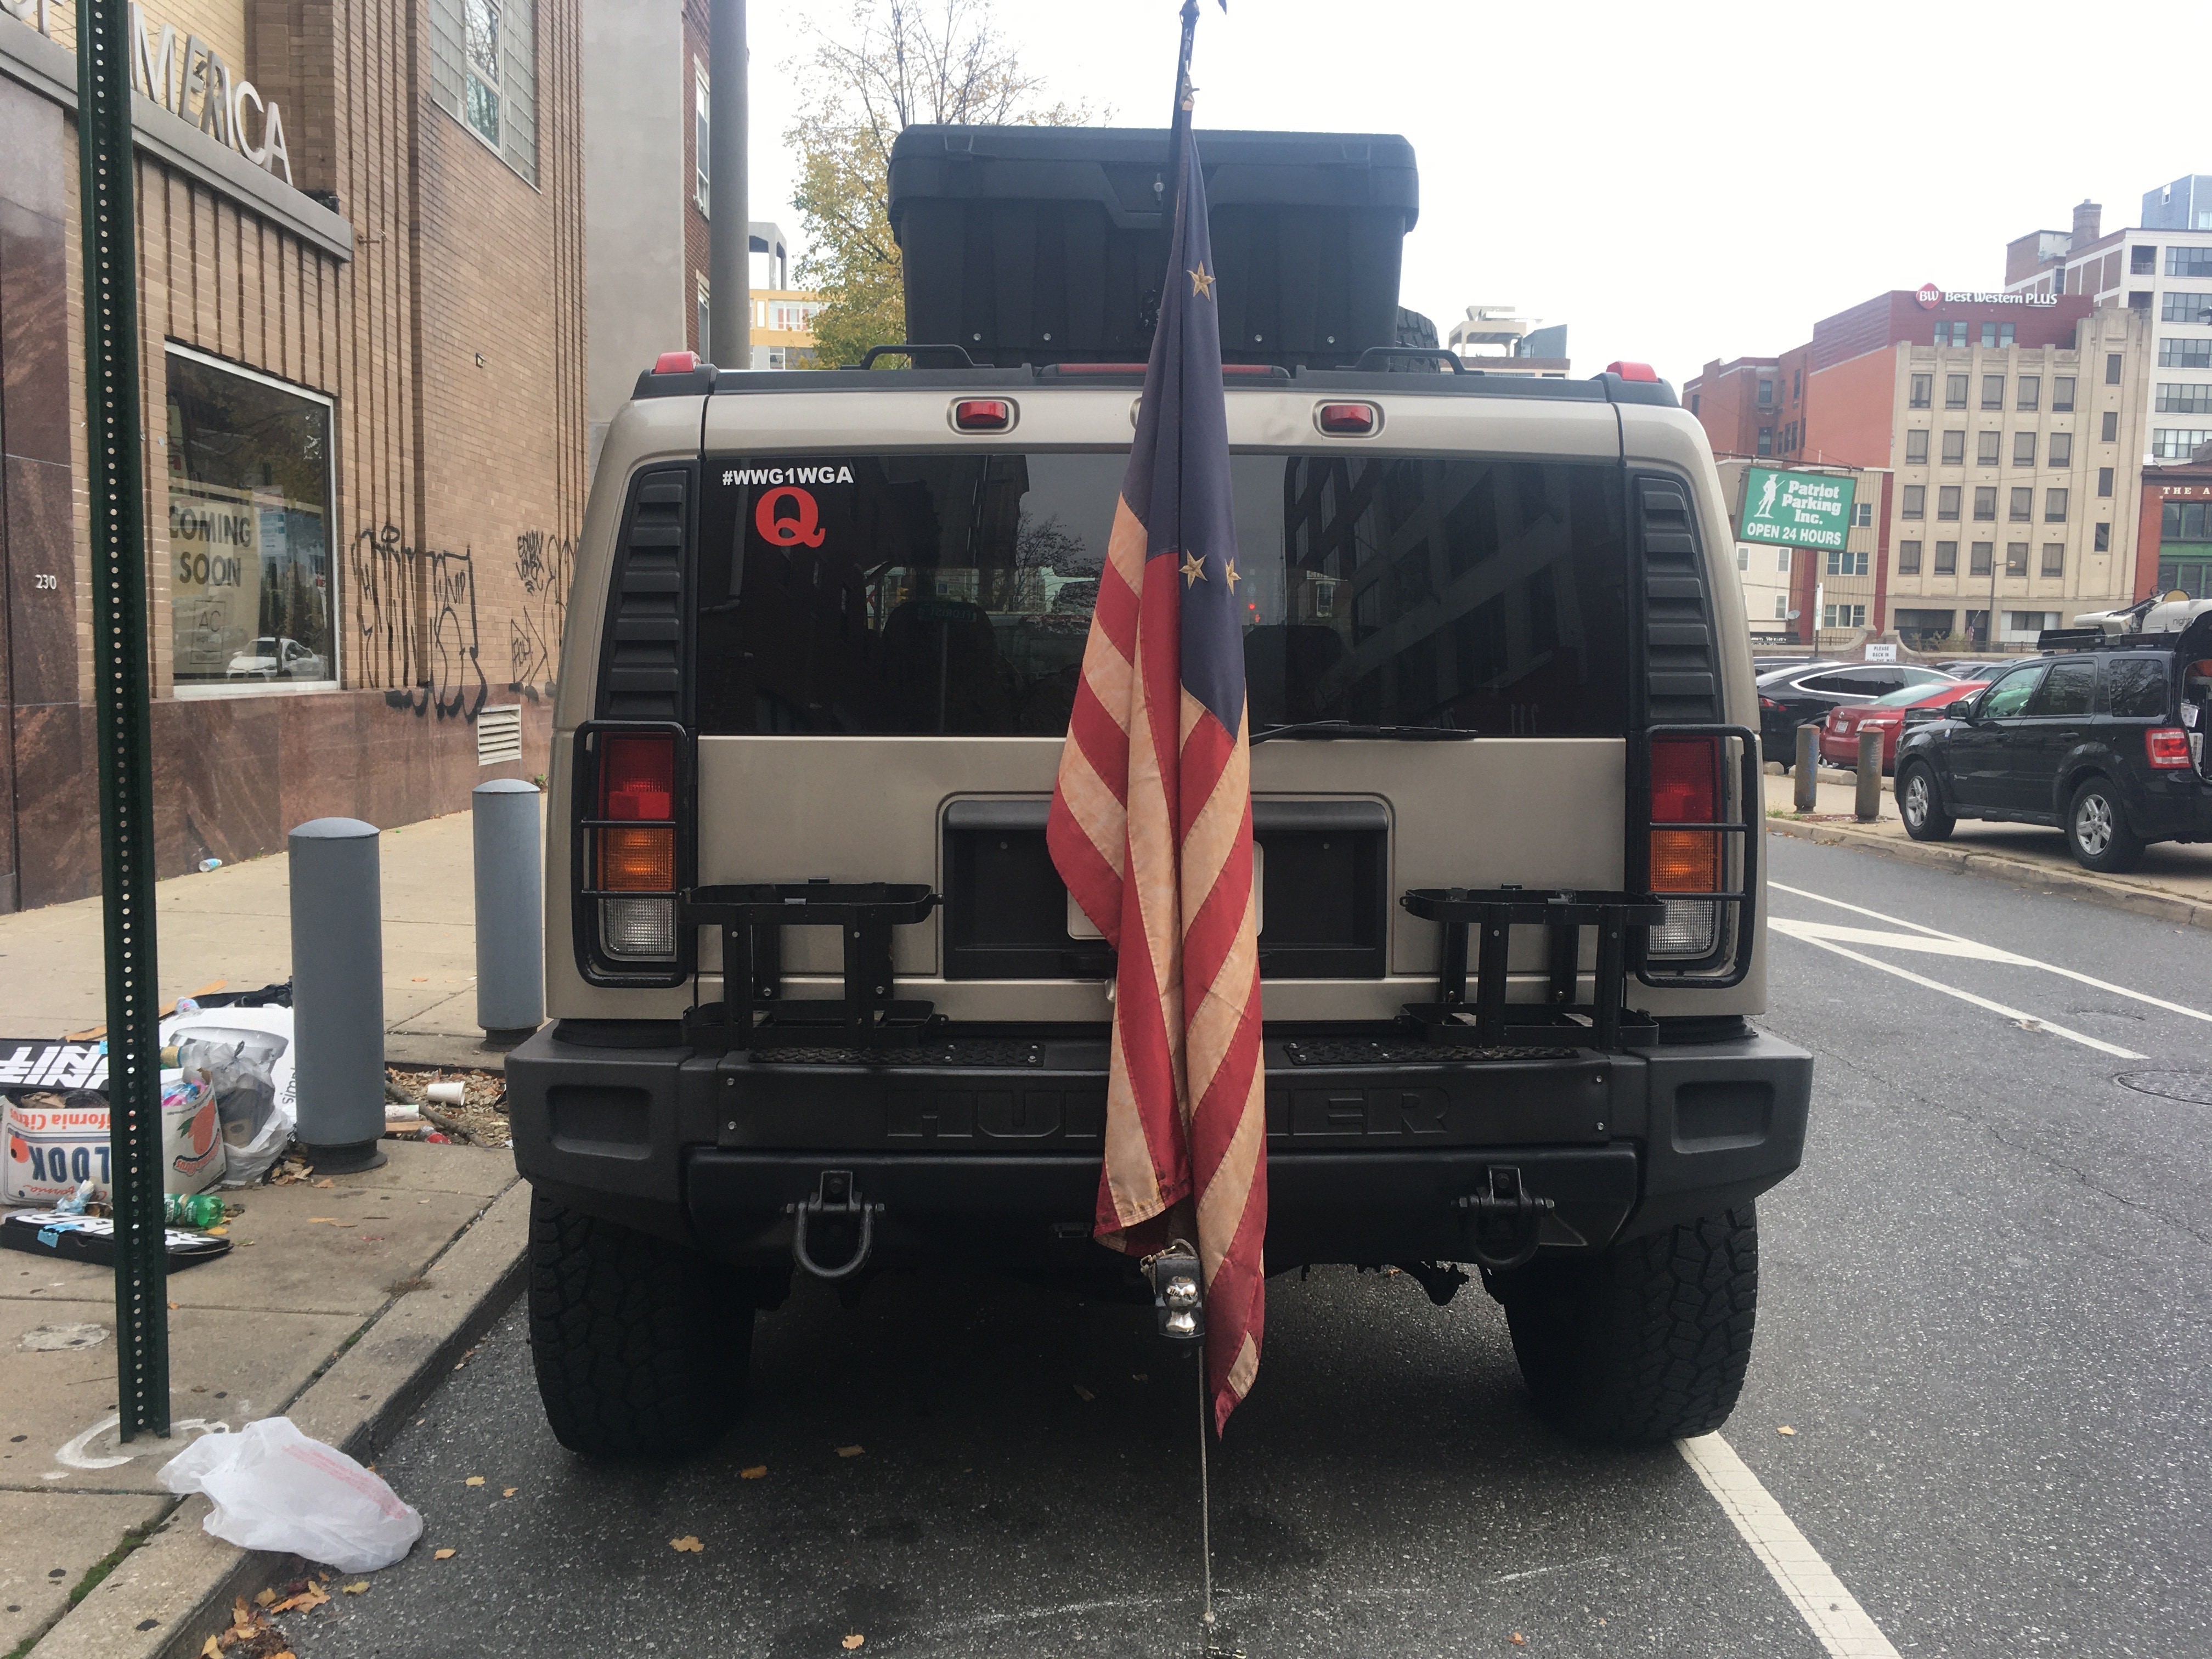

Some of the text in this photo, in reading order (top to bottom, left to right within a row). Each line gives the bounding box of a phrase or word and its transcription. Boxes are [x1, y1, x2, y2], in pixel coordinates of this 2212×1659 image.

[128, 2, 293, 187] MERICA
[1920, 290, 1939, 302] BW
[1945, 292, 2057, 304] Best Western PLUS
[723, 466, 854, 486] #WWG1WGA
[1788, 480, 1840, 499] Patriot
[2163, 487, 2192, 495] THE
[1781, 493, 1842, 516] Parking
[755, 486, 826, 548] Q
[1794, 509, 1823, 525] Inc.
[1747, 522, 1842, 545] OPEN 24 HOURS
[179, 551, 241, 588] SOON
[35, 574, 57, 590] 230
[10, 1108, 111, 1130] ifornia Citrus
[887, 1088, 1448, 1138] HUER
[29, 1146, 110, 1184] LOOK
